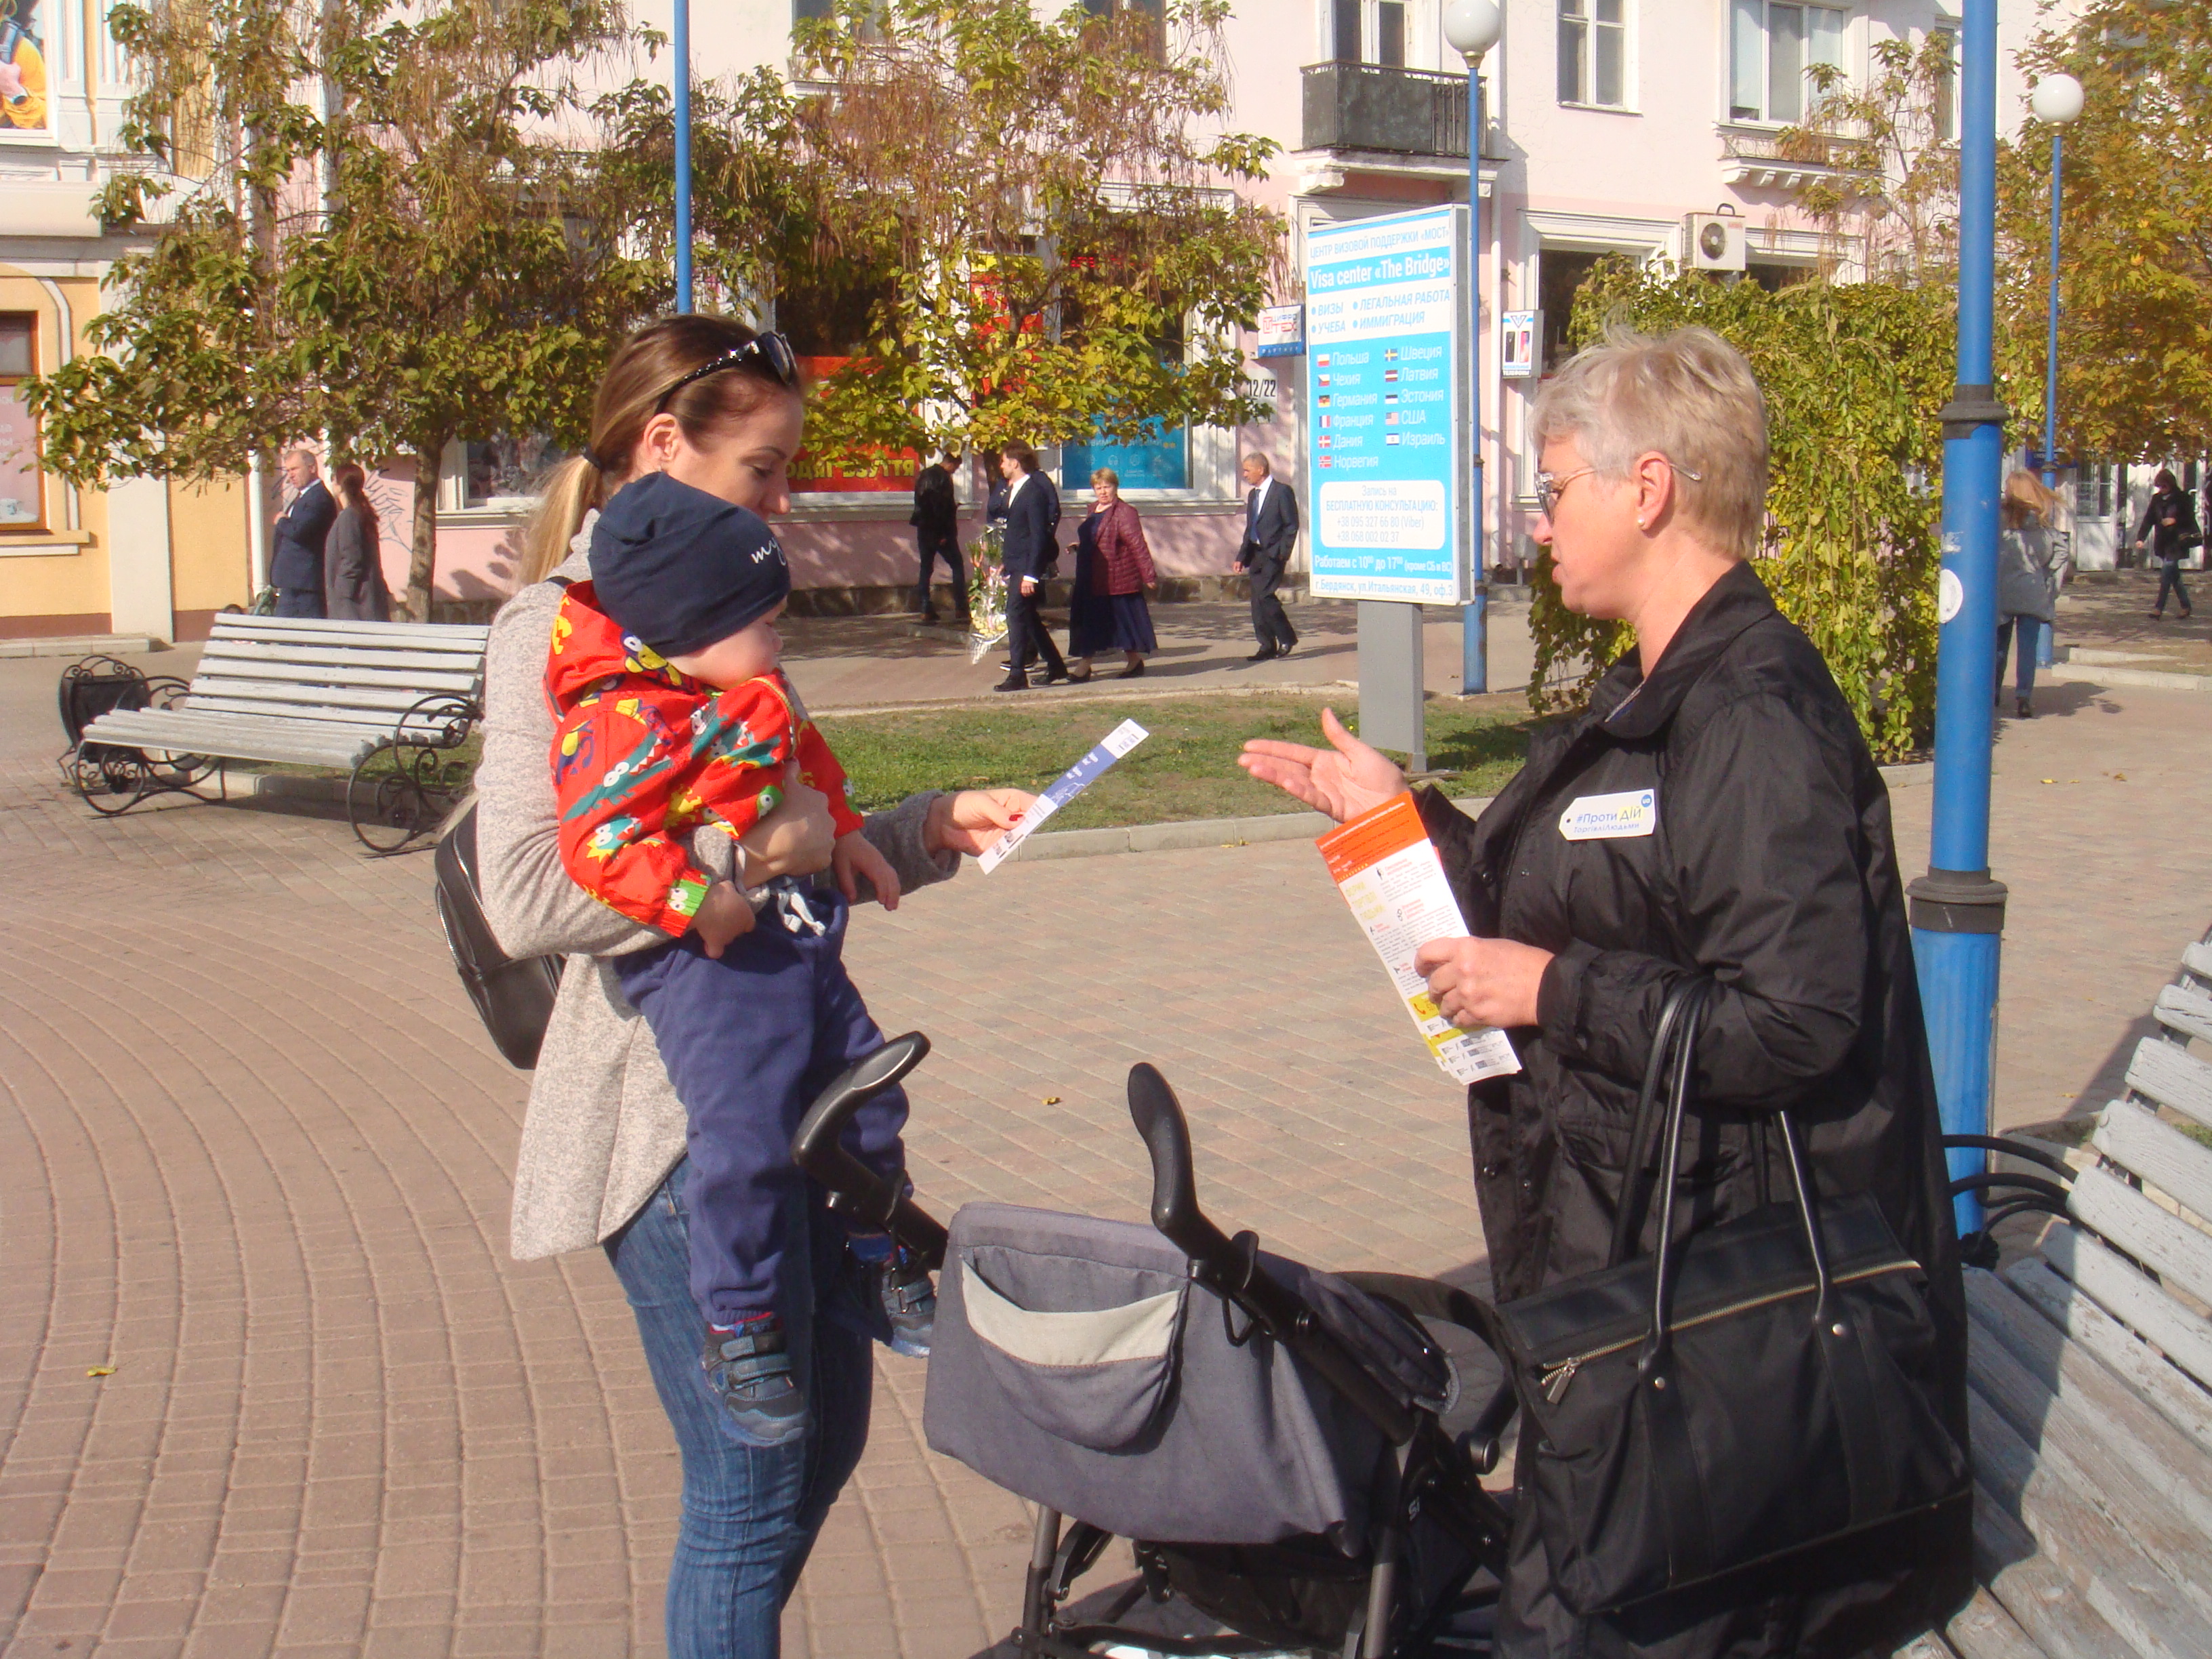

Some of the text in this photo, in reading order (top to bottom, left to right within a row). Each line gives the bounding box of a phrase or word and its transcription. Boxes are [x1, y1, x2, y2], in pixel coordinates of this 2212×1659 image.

[1310, 244, 1333, 260] ЦЕНТР
[1334, 236, 1369, 254] ВИЗОВОЙ
[1370, 230, 1418, 249] ПОДДЕРЖКИ
[1311, 268, 1334, 289] Visa
[1337, 265, 1372, 285] center
[1359, 289, 1450, 310] ЛЕГАЛЬНАЯ РАБОТА
[1318, 302, 1343, 316] ВИЗЫ
[1318, 320, 1346, 335] УЧЕБА
[1359, 311, 1425, 329] ИММИГРАЦИЯ
[1332, 351, 1369, 366] Польша
[1401, 346, 1442, 361] Швеция
[1333, 373, 1361, 387] Чехия
[1401, 367, 1439, 382] Латвия
[1332, 392, 1377, 409] Германия
[1401, 389, 1443, 404] Эстония
[1333, 413, 1374, 430] Франция
[1401, 410, 1427, 425] США
[1333, 435, 1363, 450] Дания
[1401, 432, 1446, 448] Израиль
[1334, 455, 1379, 470] Норвегия
[1361, 485, 1397, 496] Запись на
[1326, 500, 1373, 512] БЕСПЛАТНУЮ
[1315, 555, 1351, 569] Работаем
[1375, 558, 1385, 571] до
